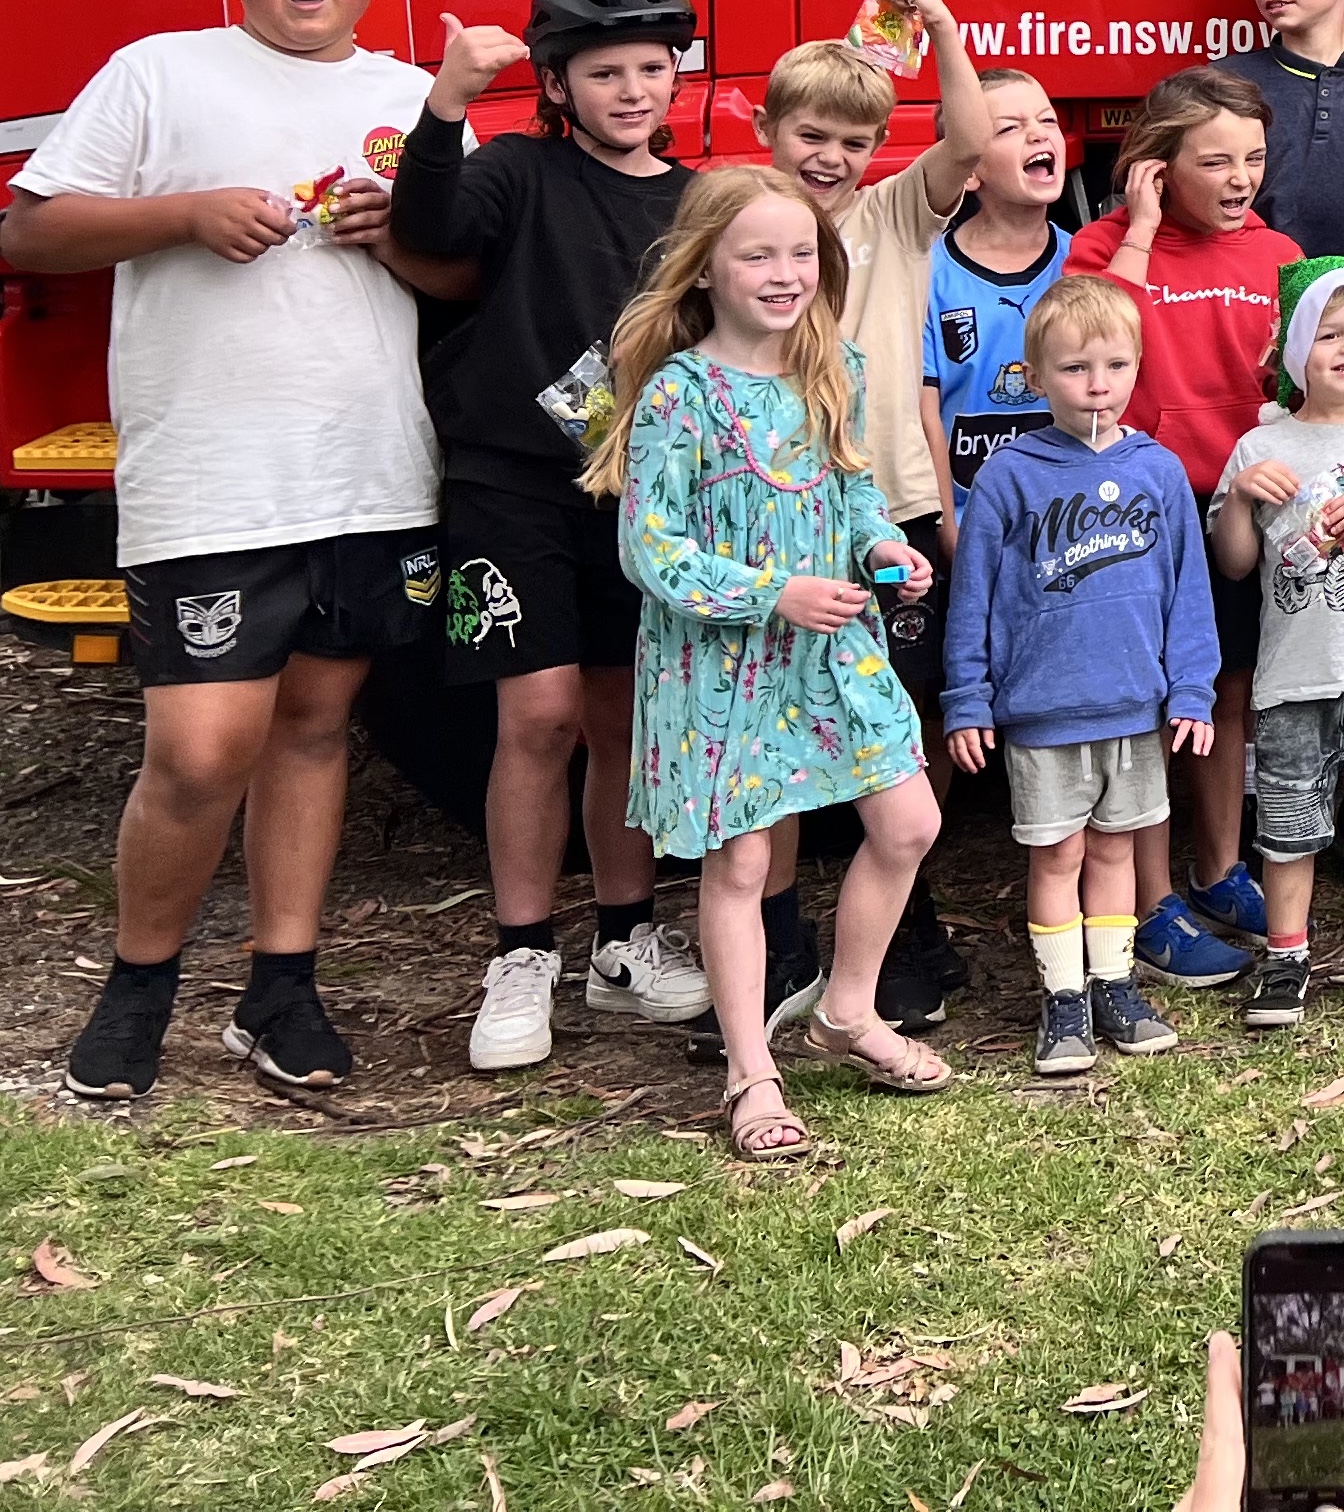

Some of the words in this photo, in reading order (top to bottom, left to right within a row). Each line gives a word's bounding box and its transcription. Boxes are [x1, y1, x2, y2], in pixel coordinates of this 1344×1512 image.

[362, 133, 408, 157] SANTA
[956, 426, 1024, 461] bryd
[1025, 492, 1160, 564] Mooks
[406, 553, 437, 575] NRL
[1064, 533, 1130, 567] Clothing
[1058, 574, 1076, 589] 66
